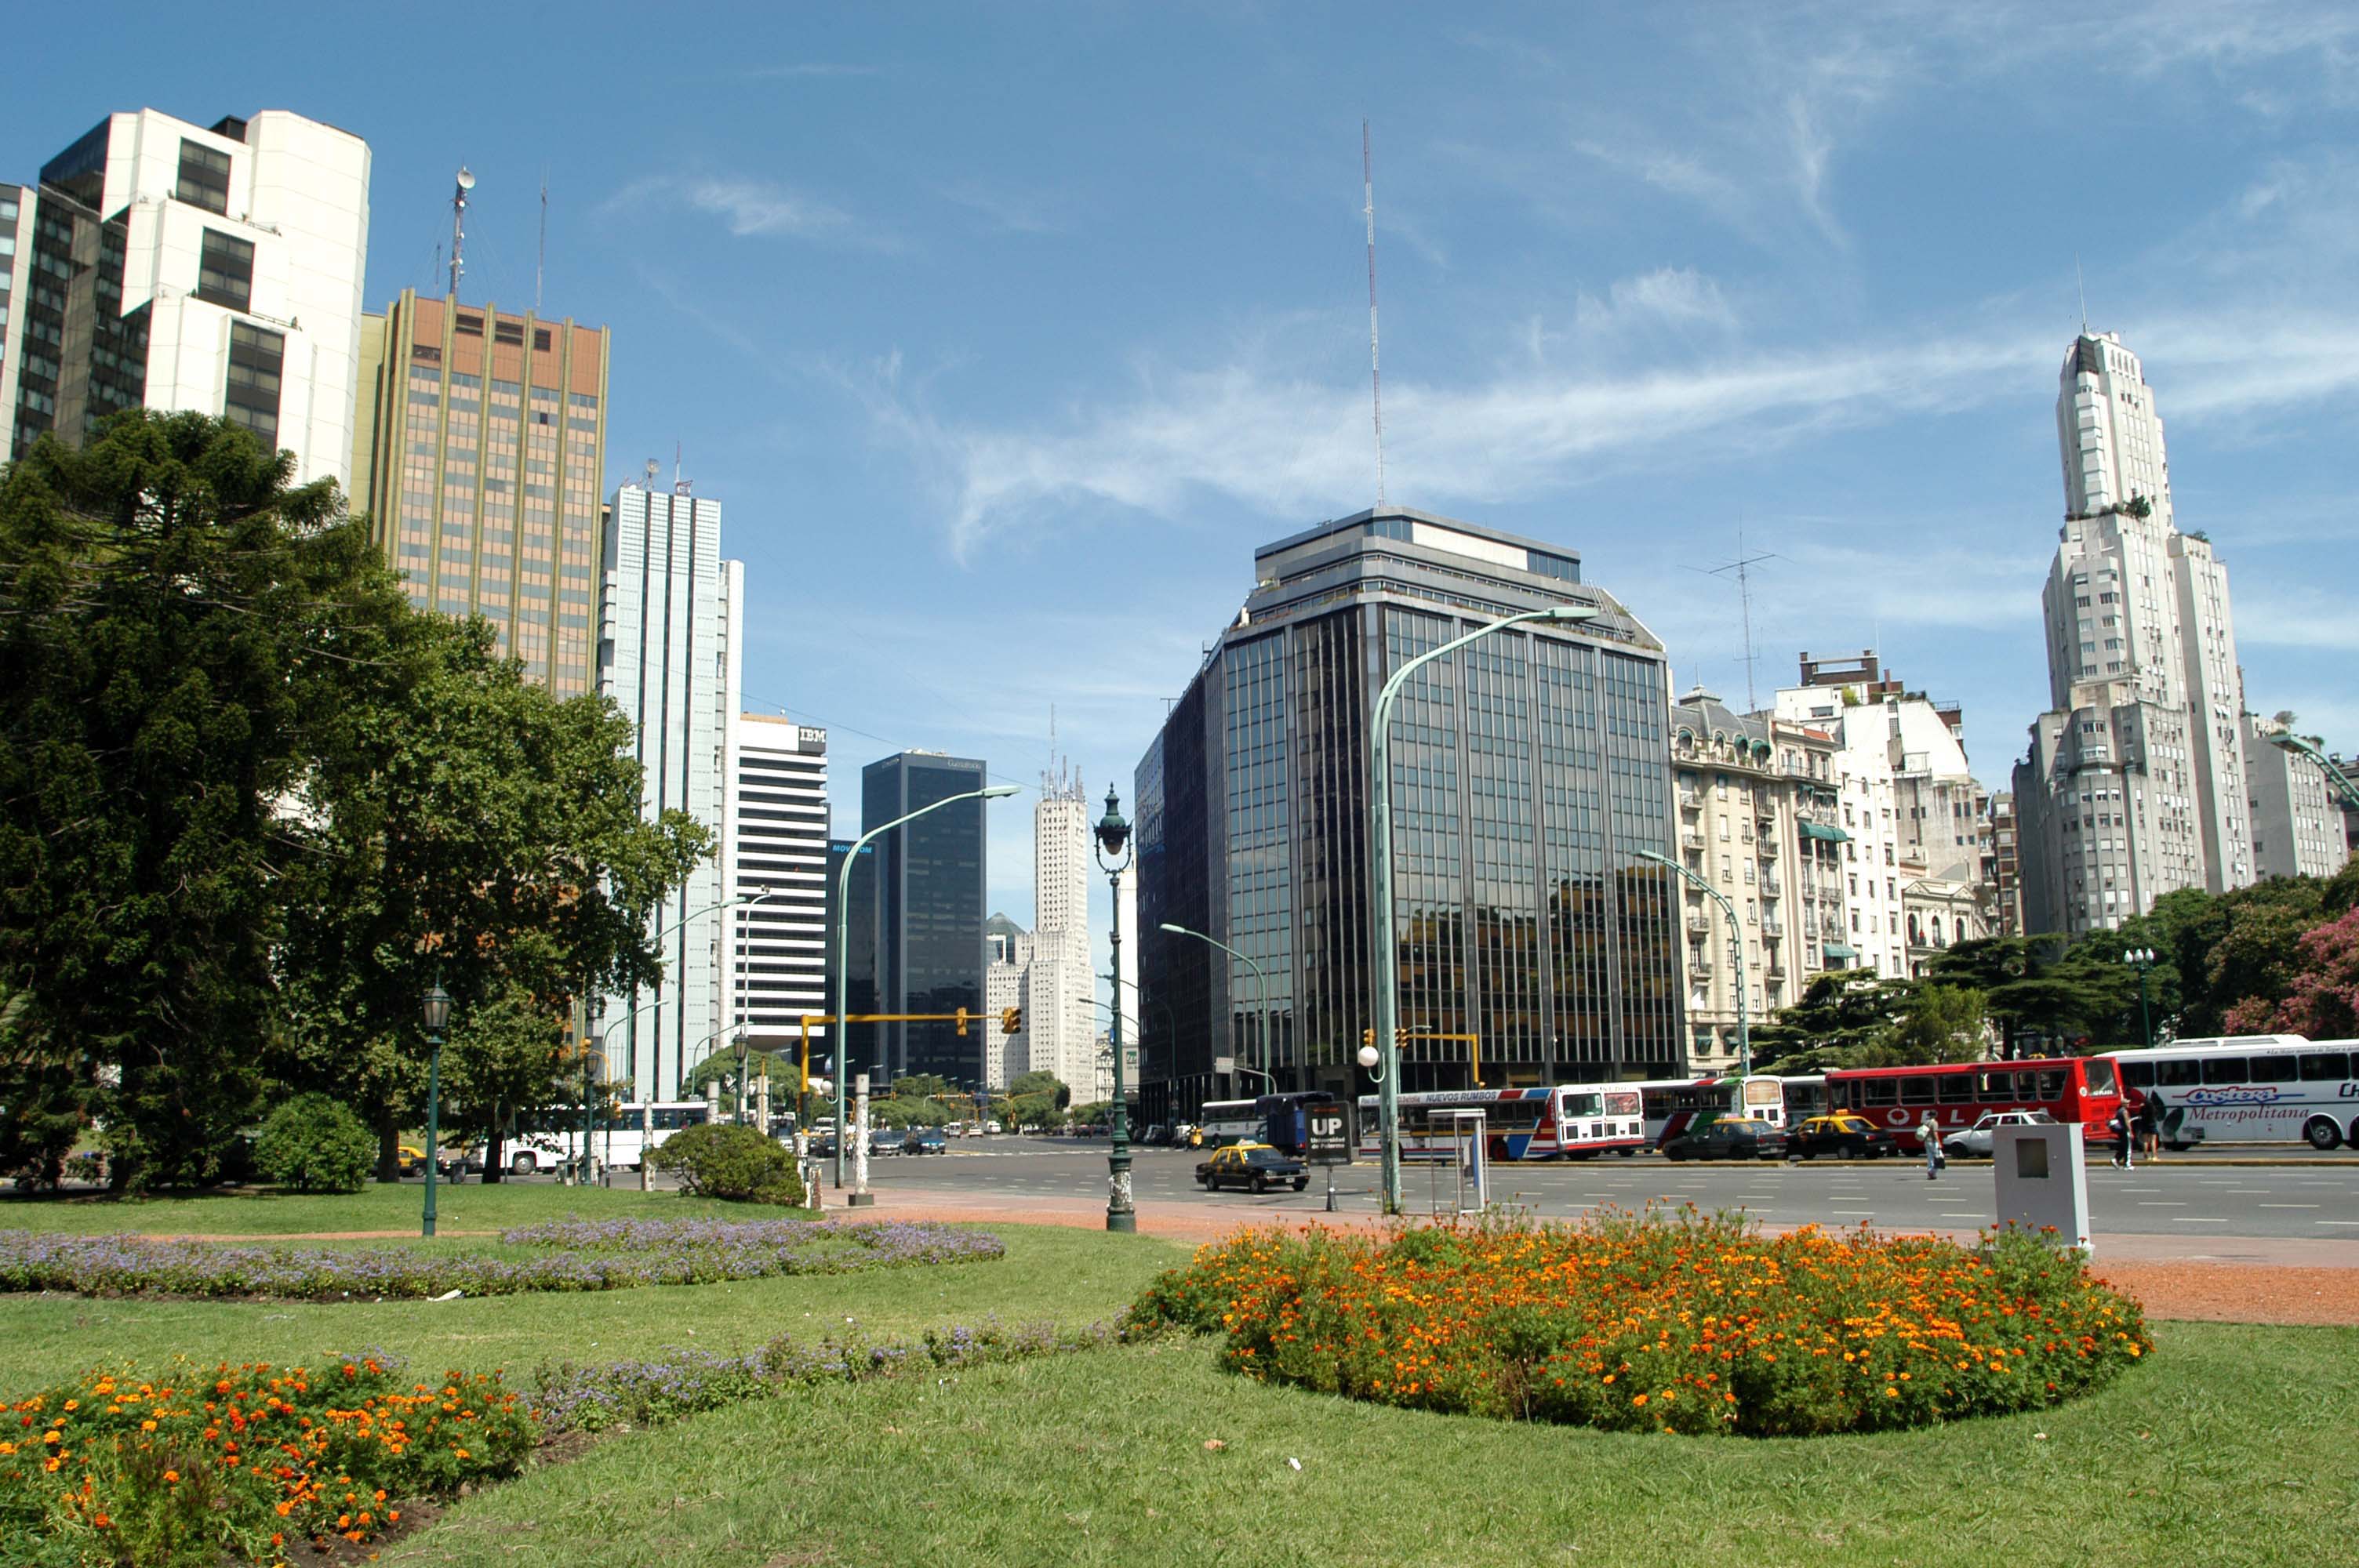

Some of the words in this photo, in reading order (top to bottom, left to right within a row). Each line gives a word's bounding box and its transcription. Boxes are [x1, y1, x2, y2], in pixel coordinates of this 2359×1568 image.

[800, 728, 826, 742] IBM
[833, 844, 872, 853] MOVOM
[1426, 1093, 1459, 1102] NUEVOS
[1460, 1091, 1496, 1101] RUMBOS
[2189, 1105, 2310, 1123] Metropolitana
[1311, 1118, 1343, 1135] UP
